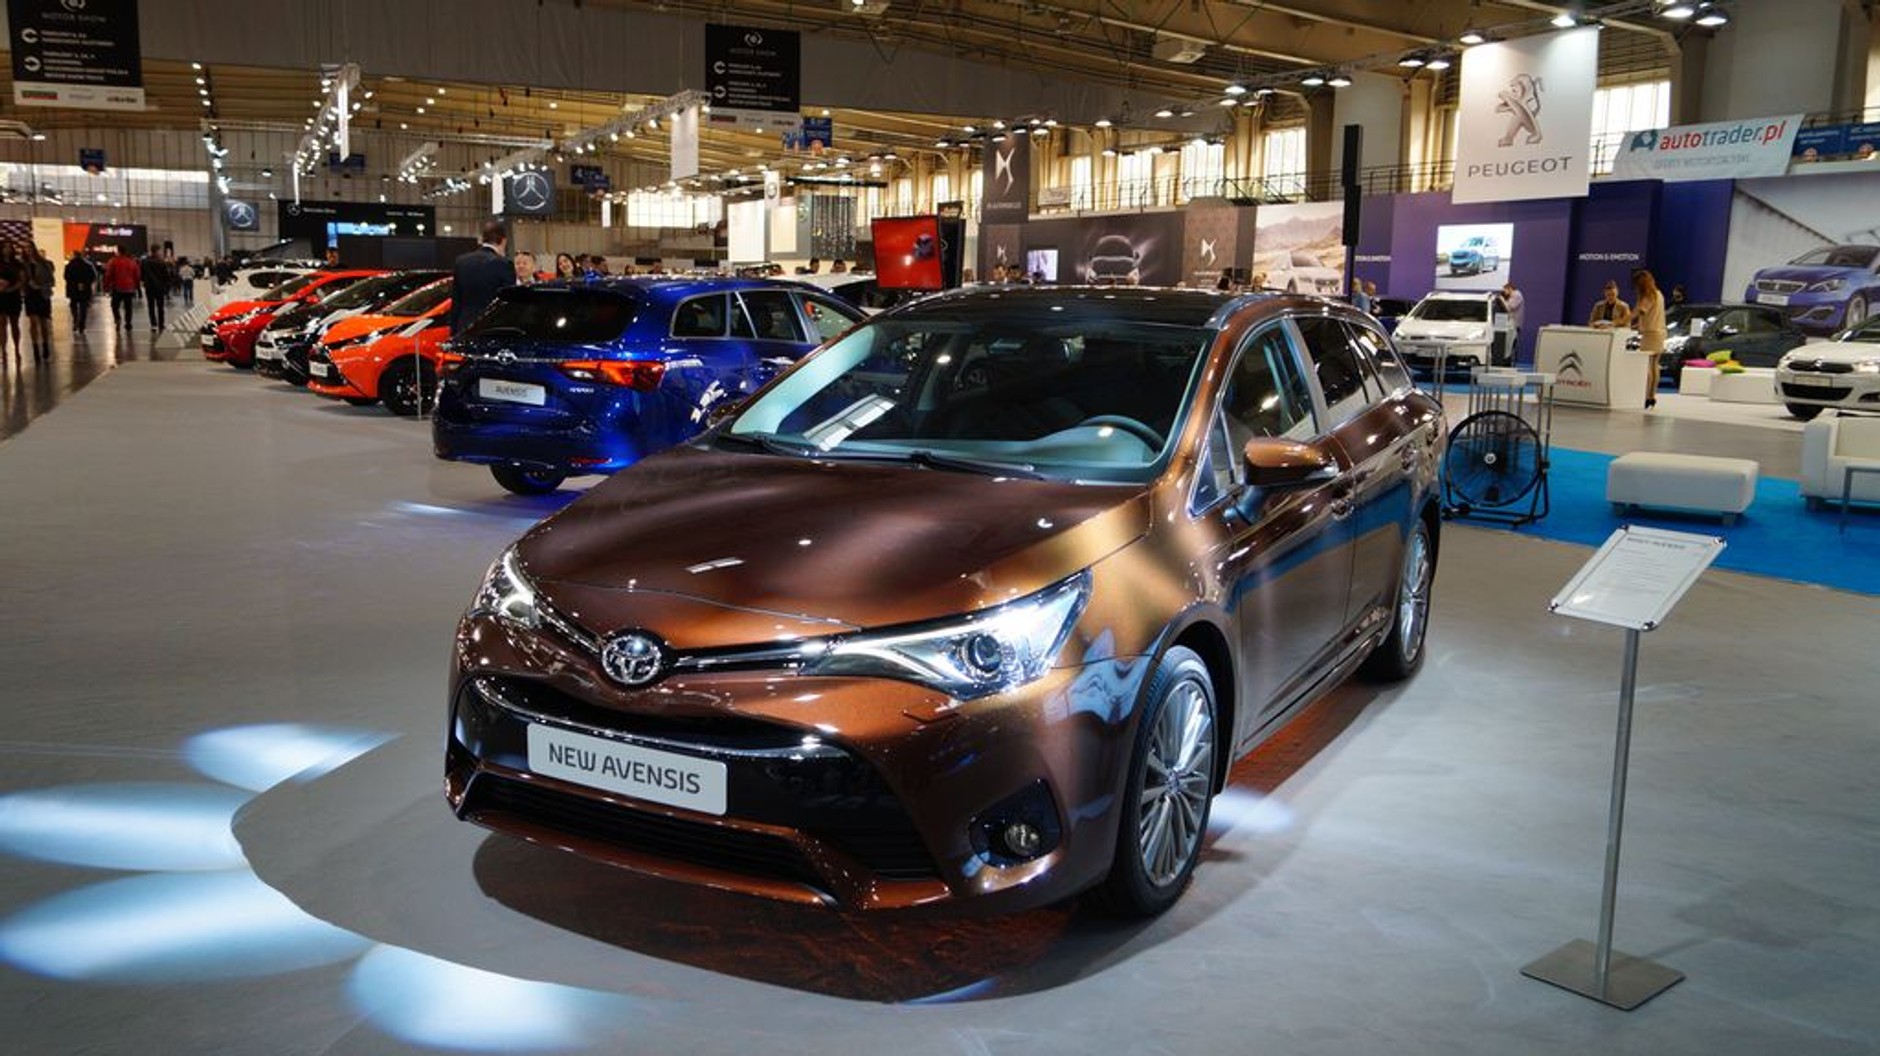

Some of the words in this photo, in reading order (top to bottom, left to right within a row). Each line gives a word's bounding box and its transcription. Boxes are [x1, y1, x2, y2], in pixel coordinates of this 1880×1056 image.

[1660, 120, 1787, 150] autotrader.pl
[1469, 156, 1573, 177] PEUGEOT
[549, 743, 597, 772] NEW
[602, 755, 700, 794] AVENSIS
